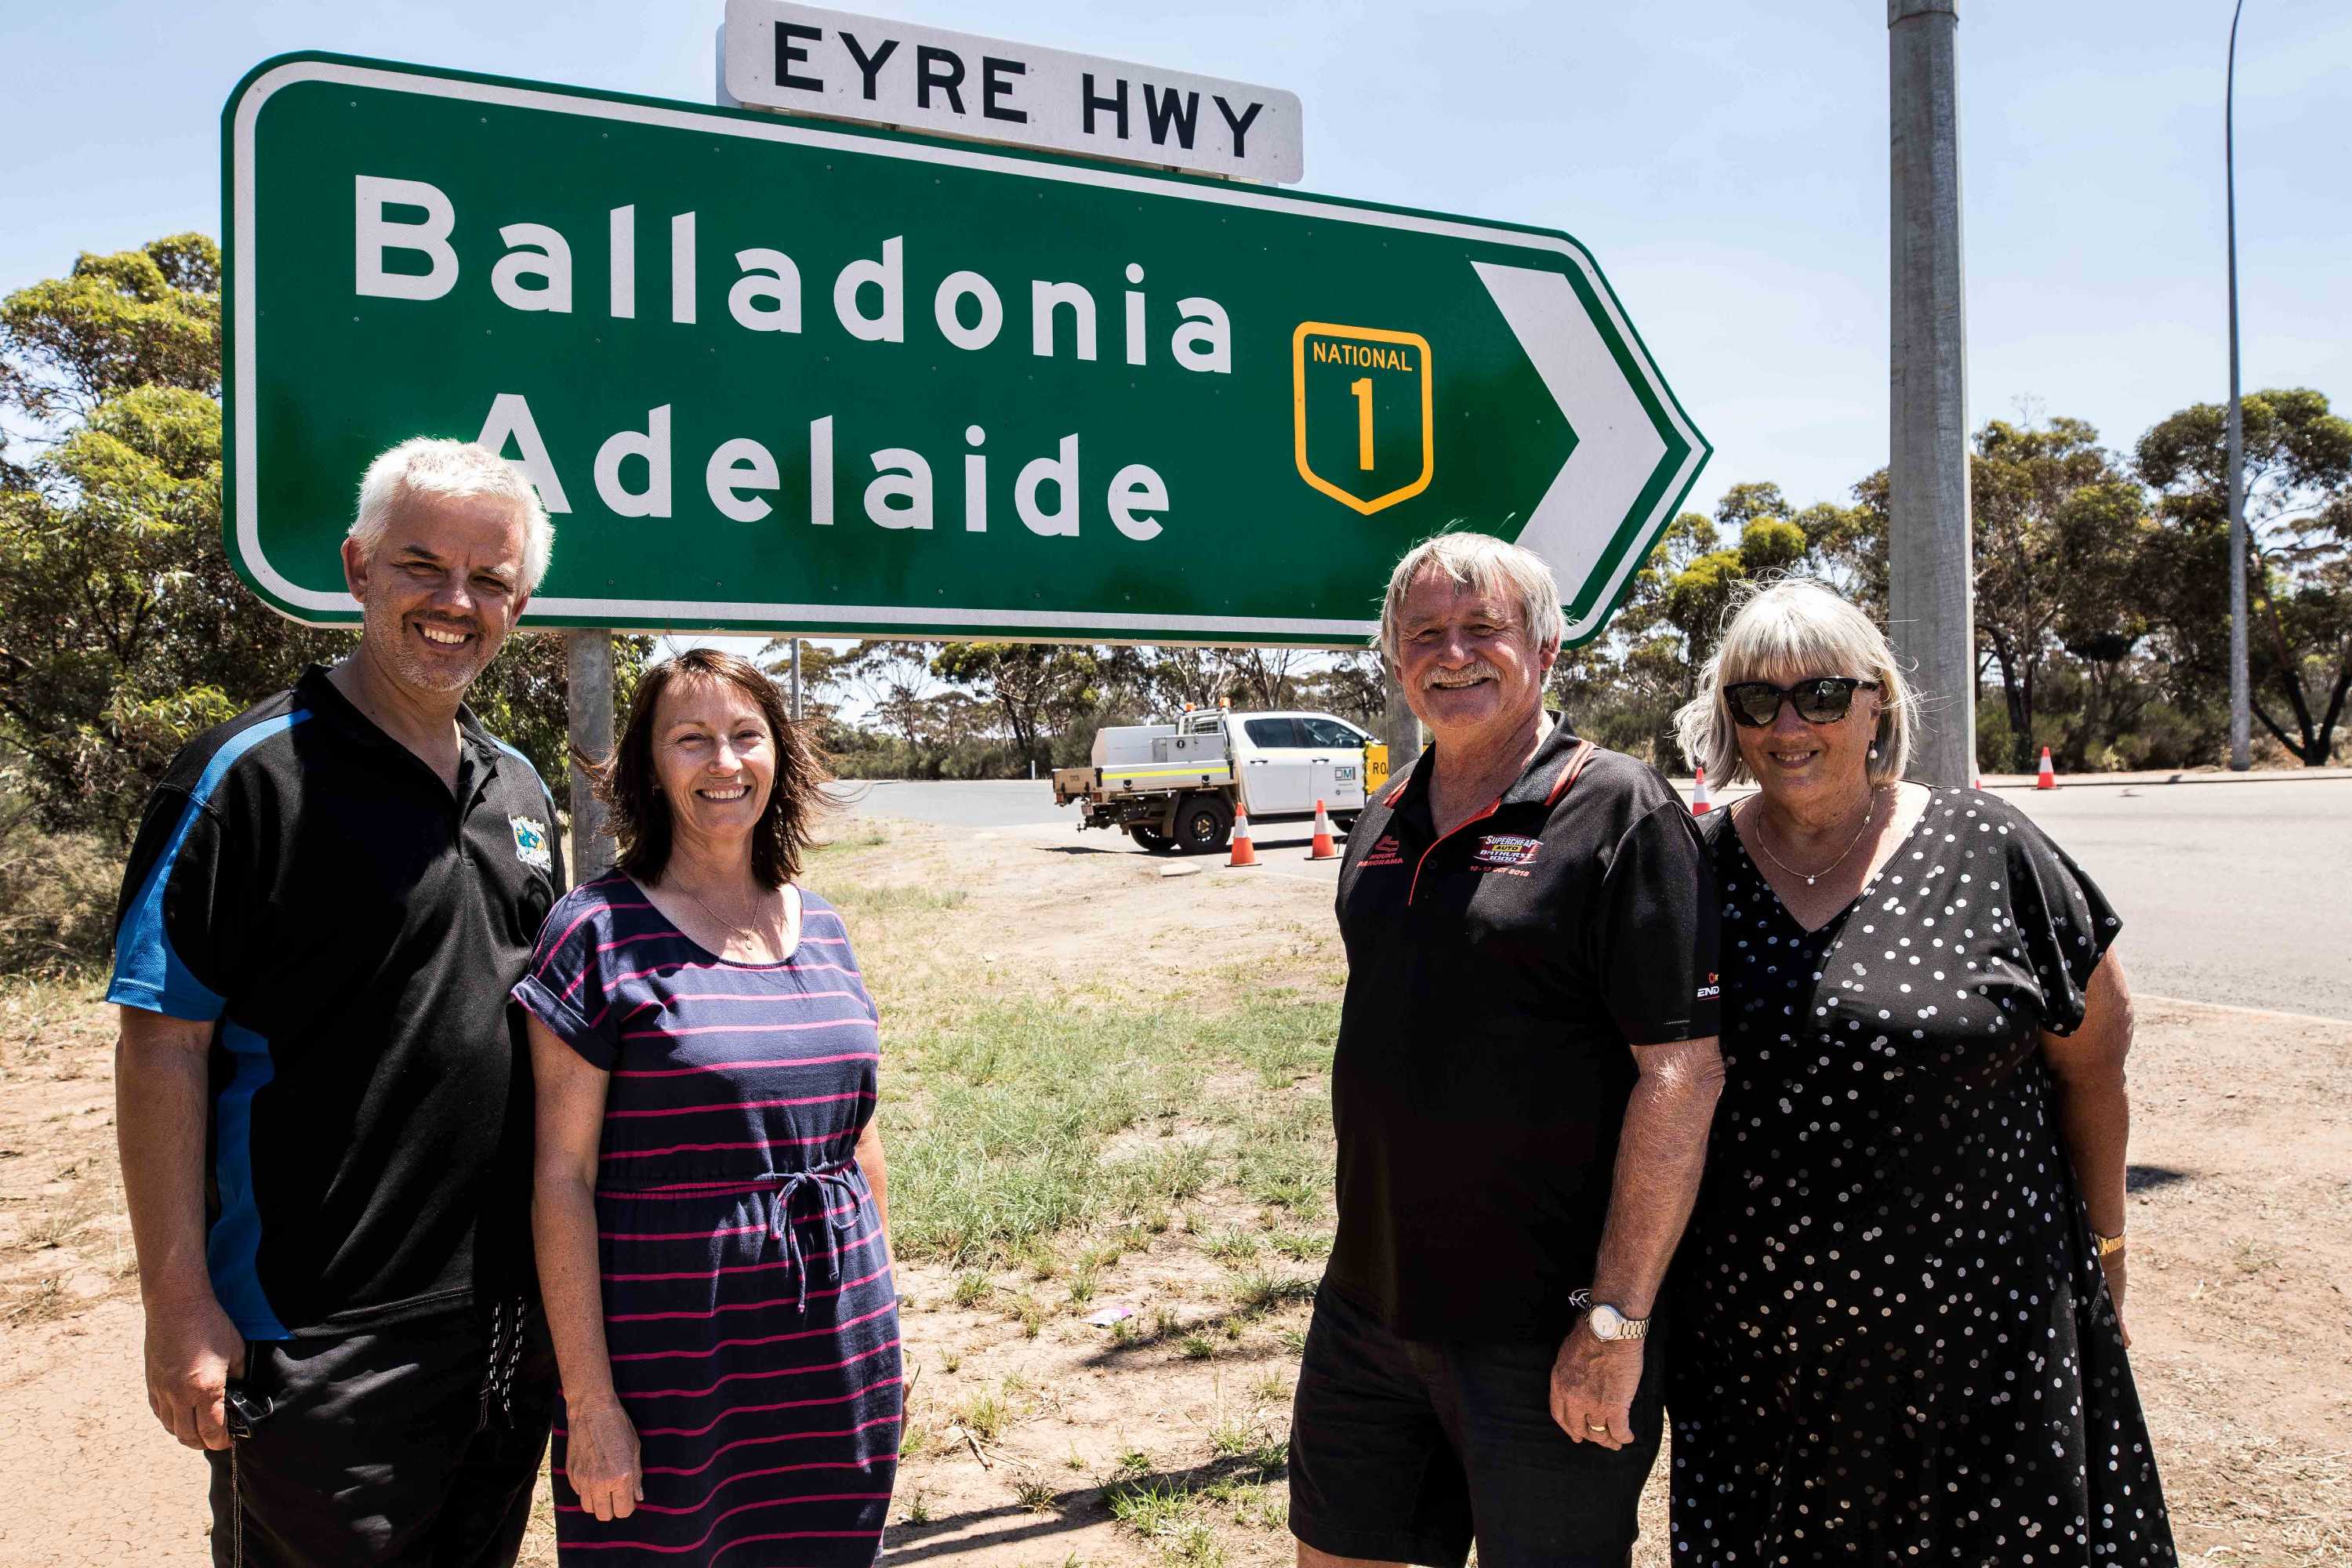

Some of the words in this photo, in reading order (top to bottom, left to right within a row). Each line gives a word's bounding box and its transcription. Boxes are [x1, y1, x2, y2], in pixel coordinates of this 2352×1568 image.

[775, 21, 1027, 124] EYRE
[1082, 73, 1263, 158] HWY
[355, 175, 1232, 374] Balladonia
[1313, 342, 1413, 372] NATIONAL
[1352, 378, 1374, 470] 1
[475, 393, 1170, 542] Adelaide
[1373, 762, 1389, 775] RO
[1480, 850, 1534, 859] BATHURST
[1486, 836, 1537, 848] SUPERCHEAP
[1356, 858, 1403, 867] PANORAMA
